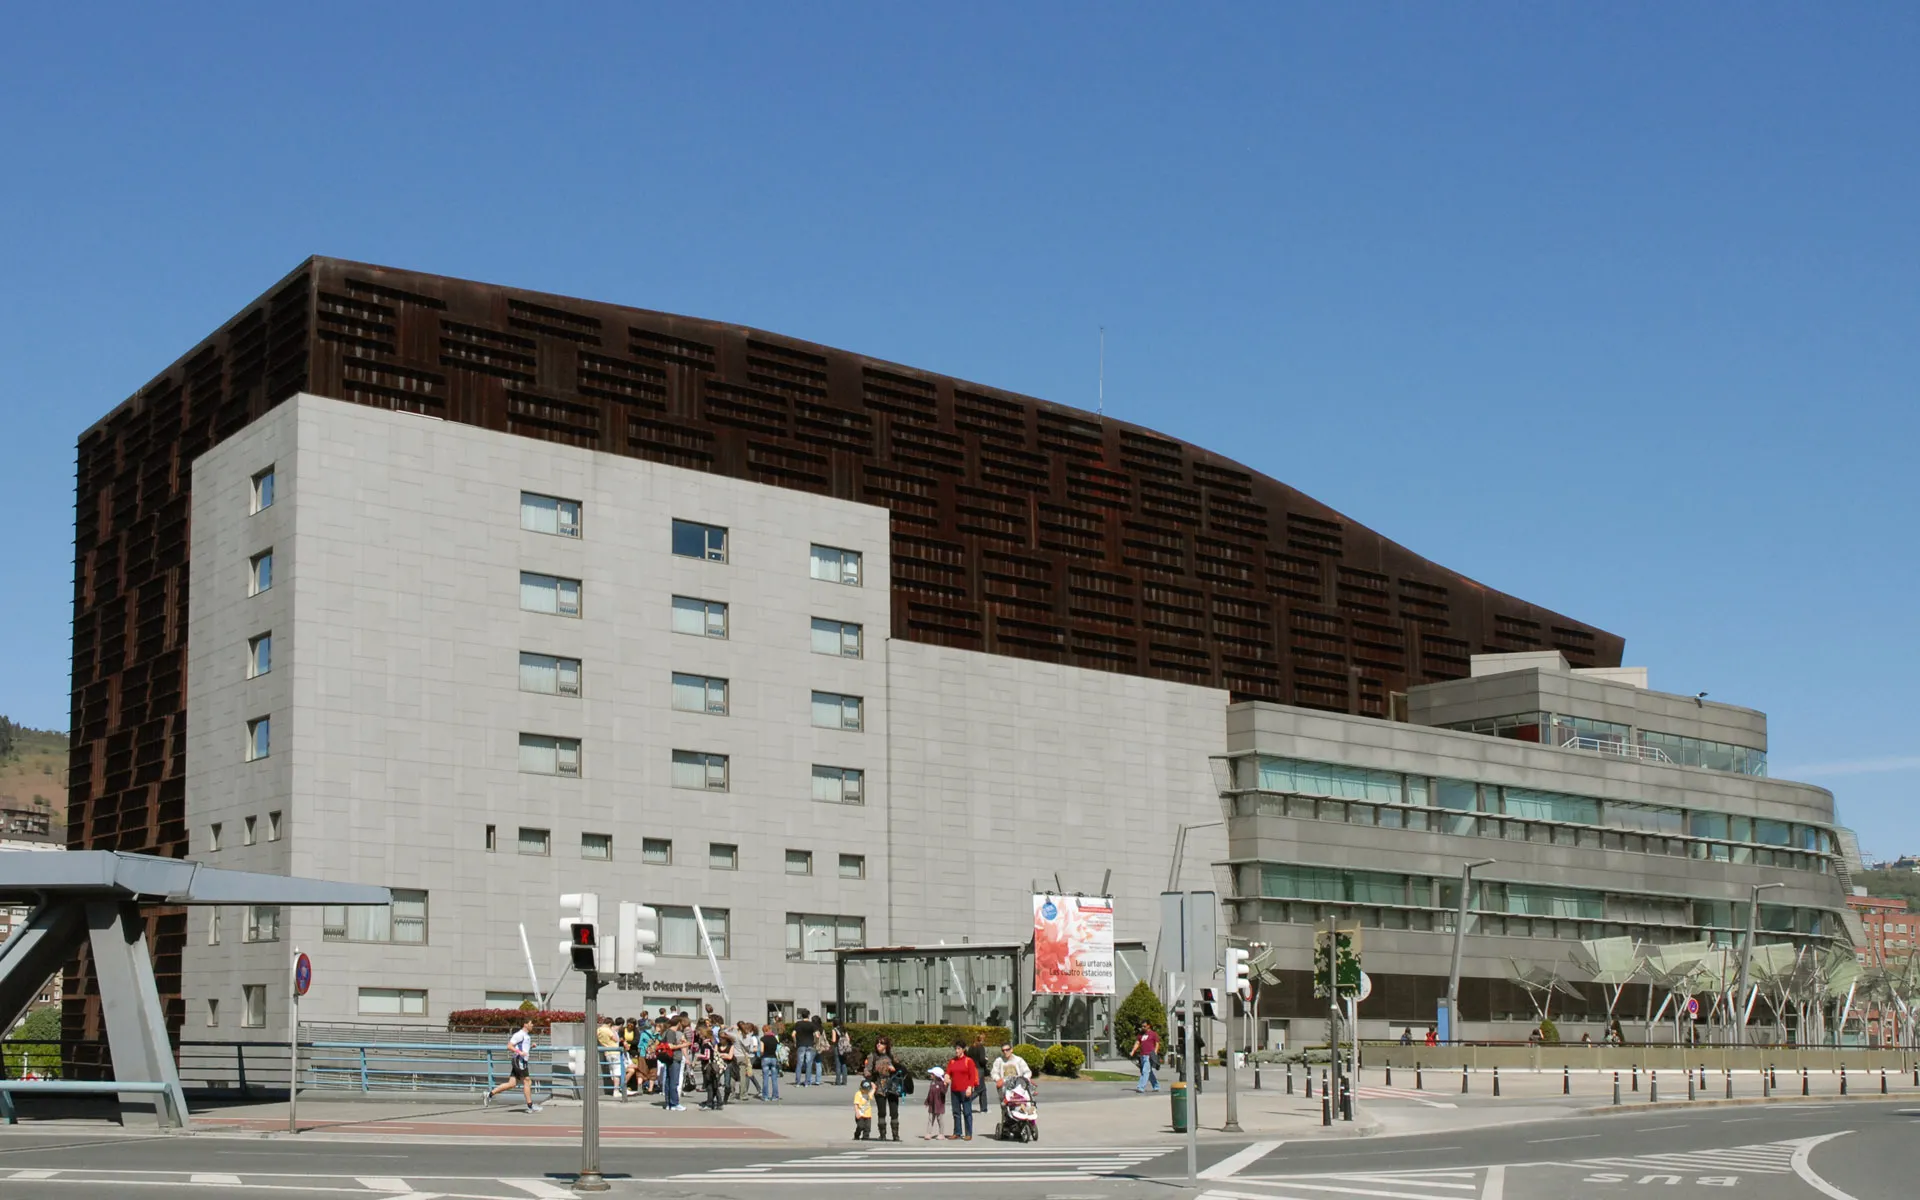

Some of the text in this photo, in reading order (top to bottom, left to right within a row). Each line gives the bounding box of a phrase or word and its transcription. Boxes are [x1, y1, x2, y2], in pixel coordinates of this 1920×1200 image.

[1075, 959, 1112, 968] Lau urtaroak
[1049, 967, 1112, 977] Las cuatro estaciones
[1583, 1173, 1739, 1187] BUS
